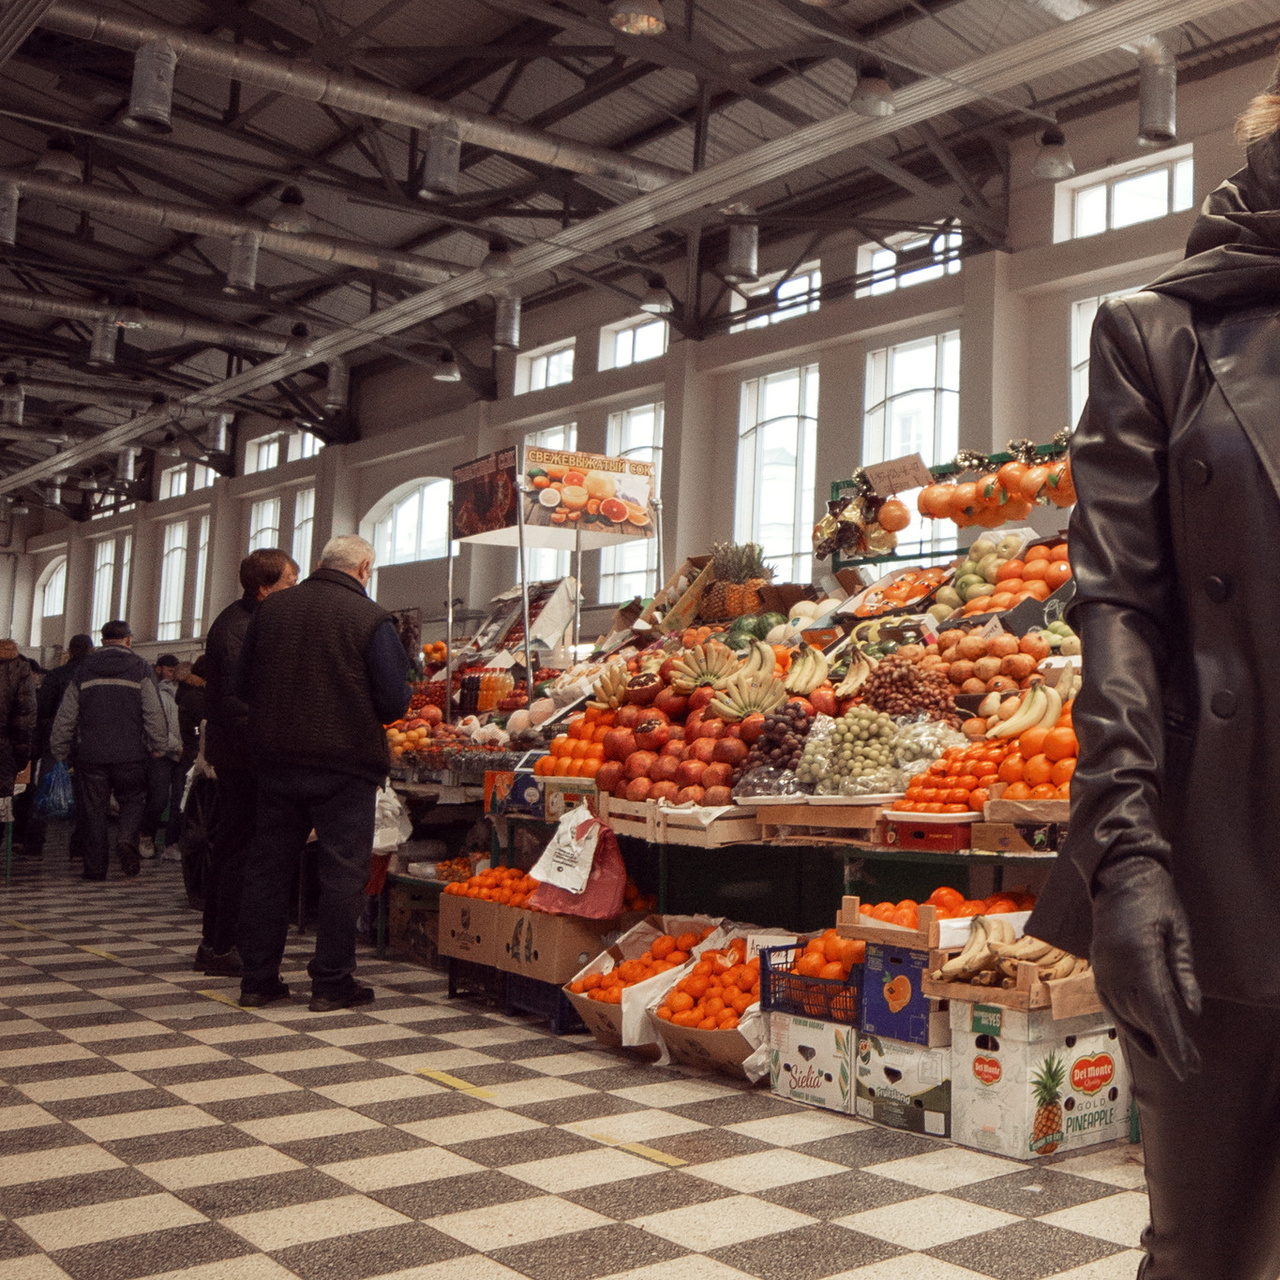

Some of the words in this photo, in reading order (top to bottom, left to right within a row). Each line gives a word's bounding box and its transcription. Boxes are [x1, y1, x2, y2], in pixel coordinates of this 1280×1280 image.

[527, 450, 626, 474] СВЕЖЕВЫЖАТЫЙ
[629, 463, 652, 476] СОК
[1074, 1067, 1087, 1081] Del
[1087, 1064, 1112, 1078] Monte
[1077, 1097, 1106, 1111] GOLD
[1065, 1107, 1115, 1134] PINEAPPLE
